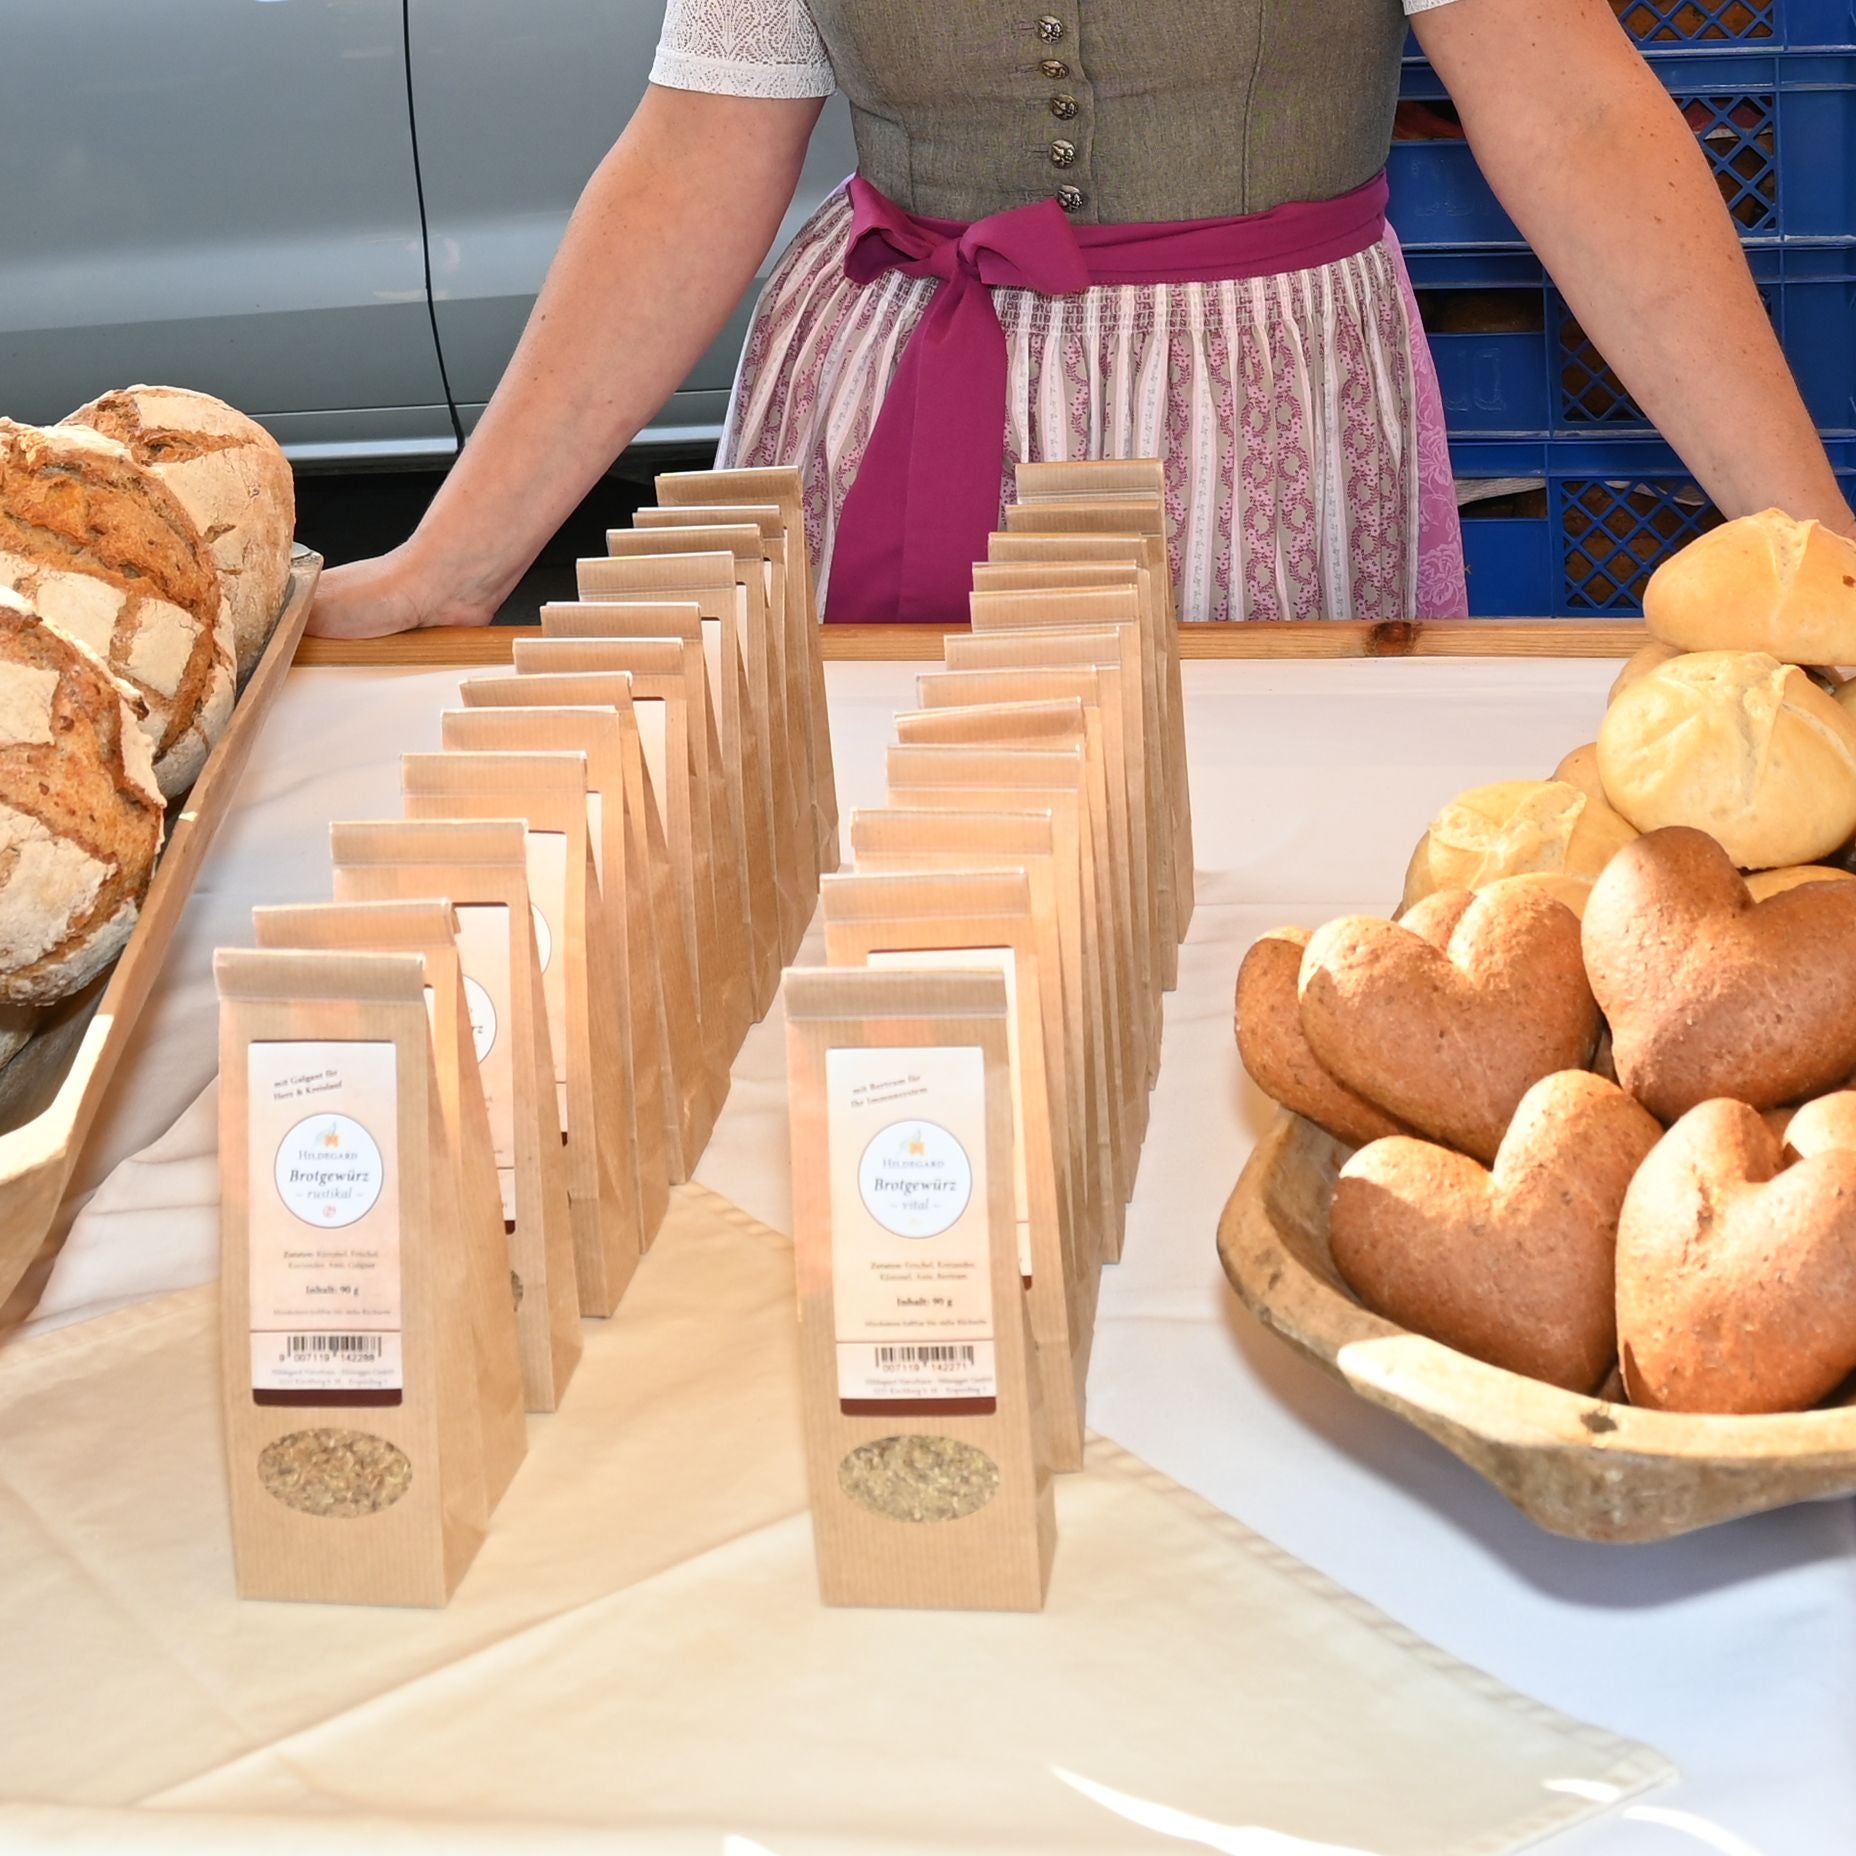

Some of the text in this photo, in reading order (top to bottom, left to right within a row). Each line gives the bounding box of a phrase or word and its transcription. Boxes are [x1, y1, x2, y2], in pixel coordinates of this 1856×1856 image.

[298, 1149, 358, 1161] HILDEGARD
[882, 1158, 945, 1170] HILDEGARD
[288, 1168, 370, 1187] Brotgewürz
[873, 1177, 958, 1196] Brotgewürz
[306, 1186, 353, 1200] rustikal
[902, 1197, 929, 1210] vital
[305, 1285, 337, 1294] Inhalt:
[896, 1296, 930, 1307] Inhalt:
